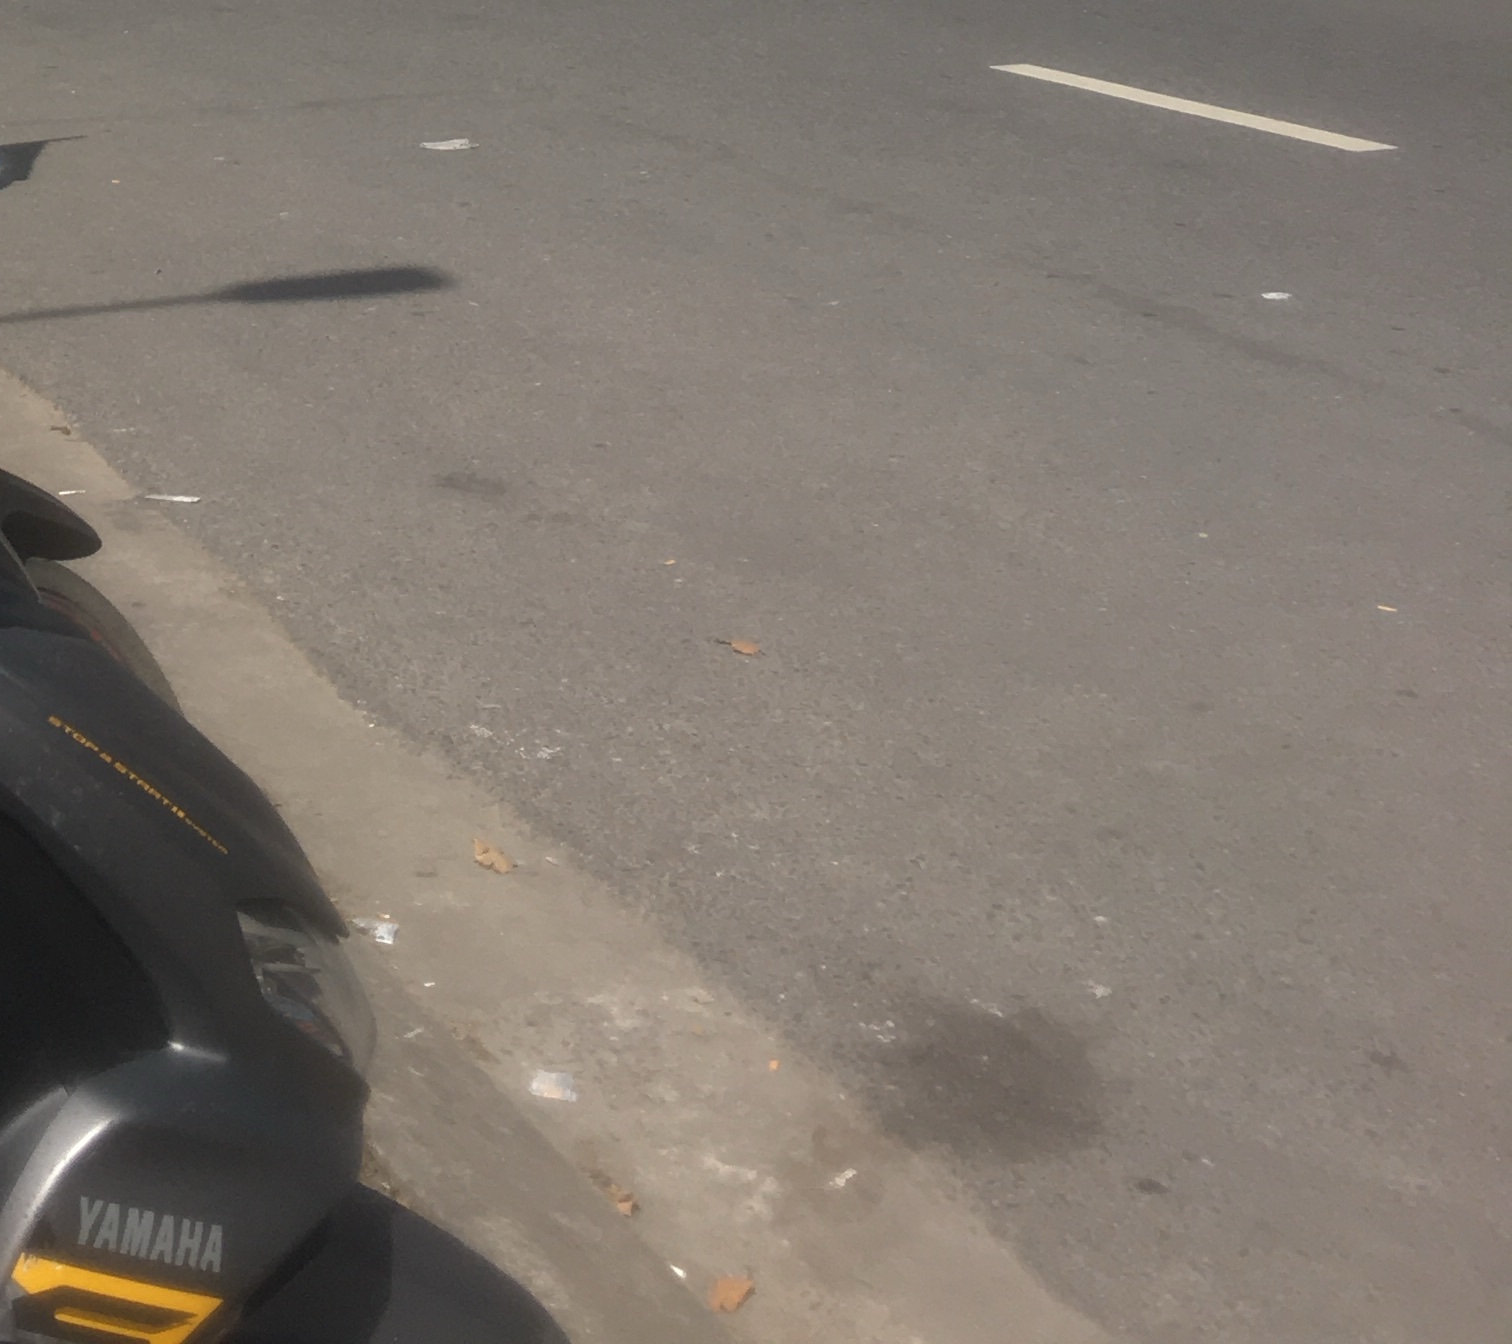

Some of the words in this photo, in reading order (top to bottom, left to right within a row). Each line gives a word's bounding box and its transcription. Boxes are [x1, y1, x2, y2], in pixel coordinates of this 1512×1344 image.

[47, 715, 100, 752] STOP
[113, 760, 173, 806] START
[77, 1195, 223, 1273] YAMAHA
